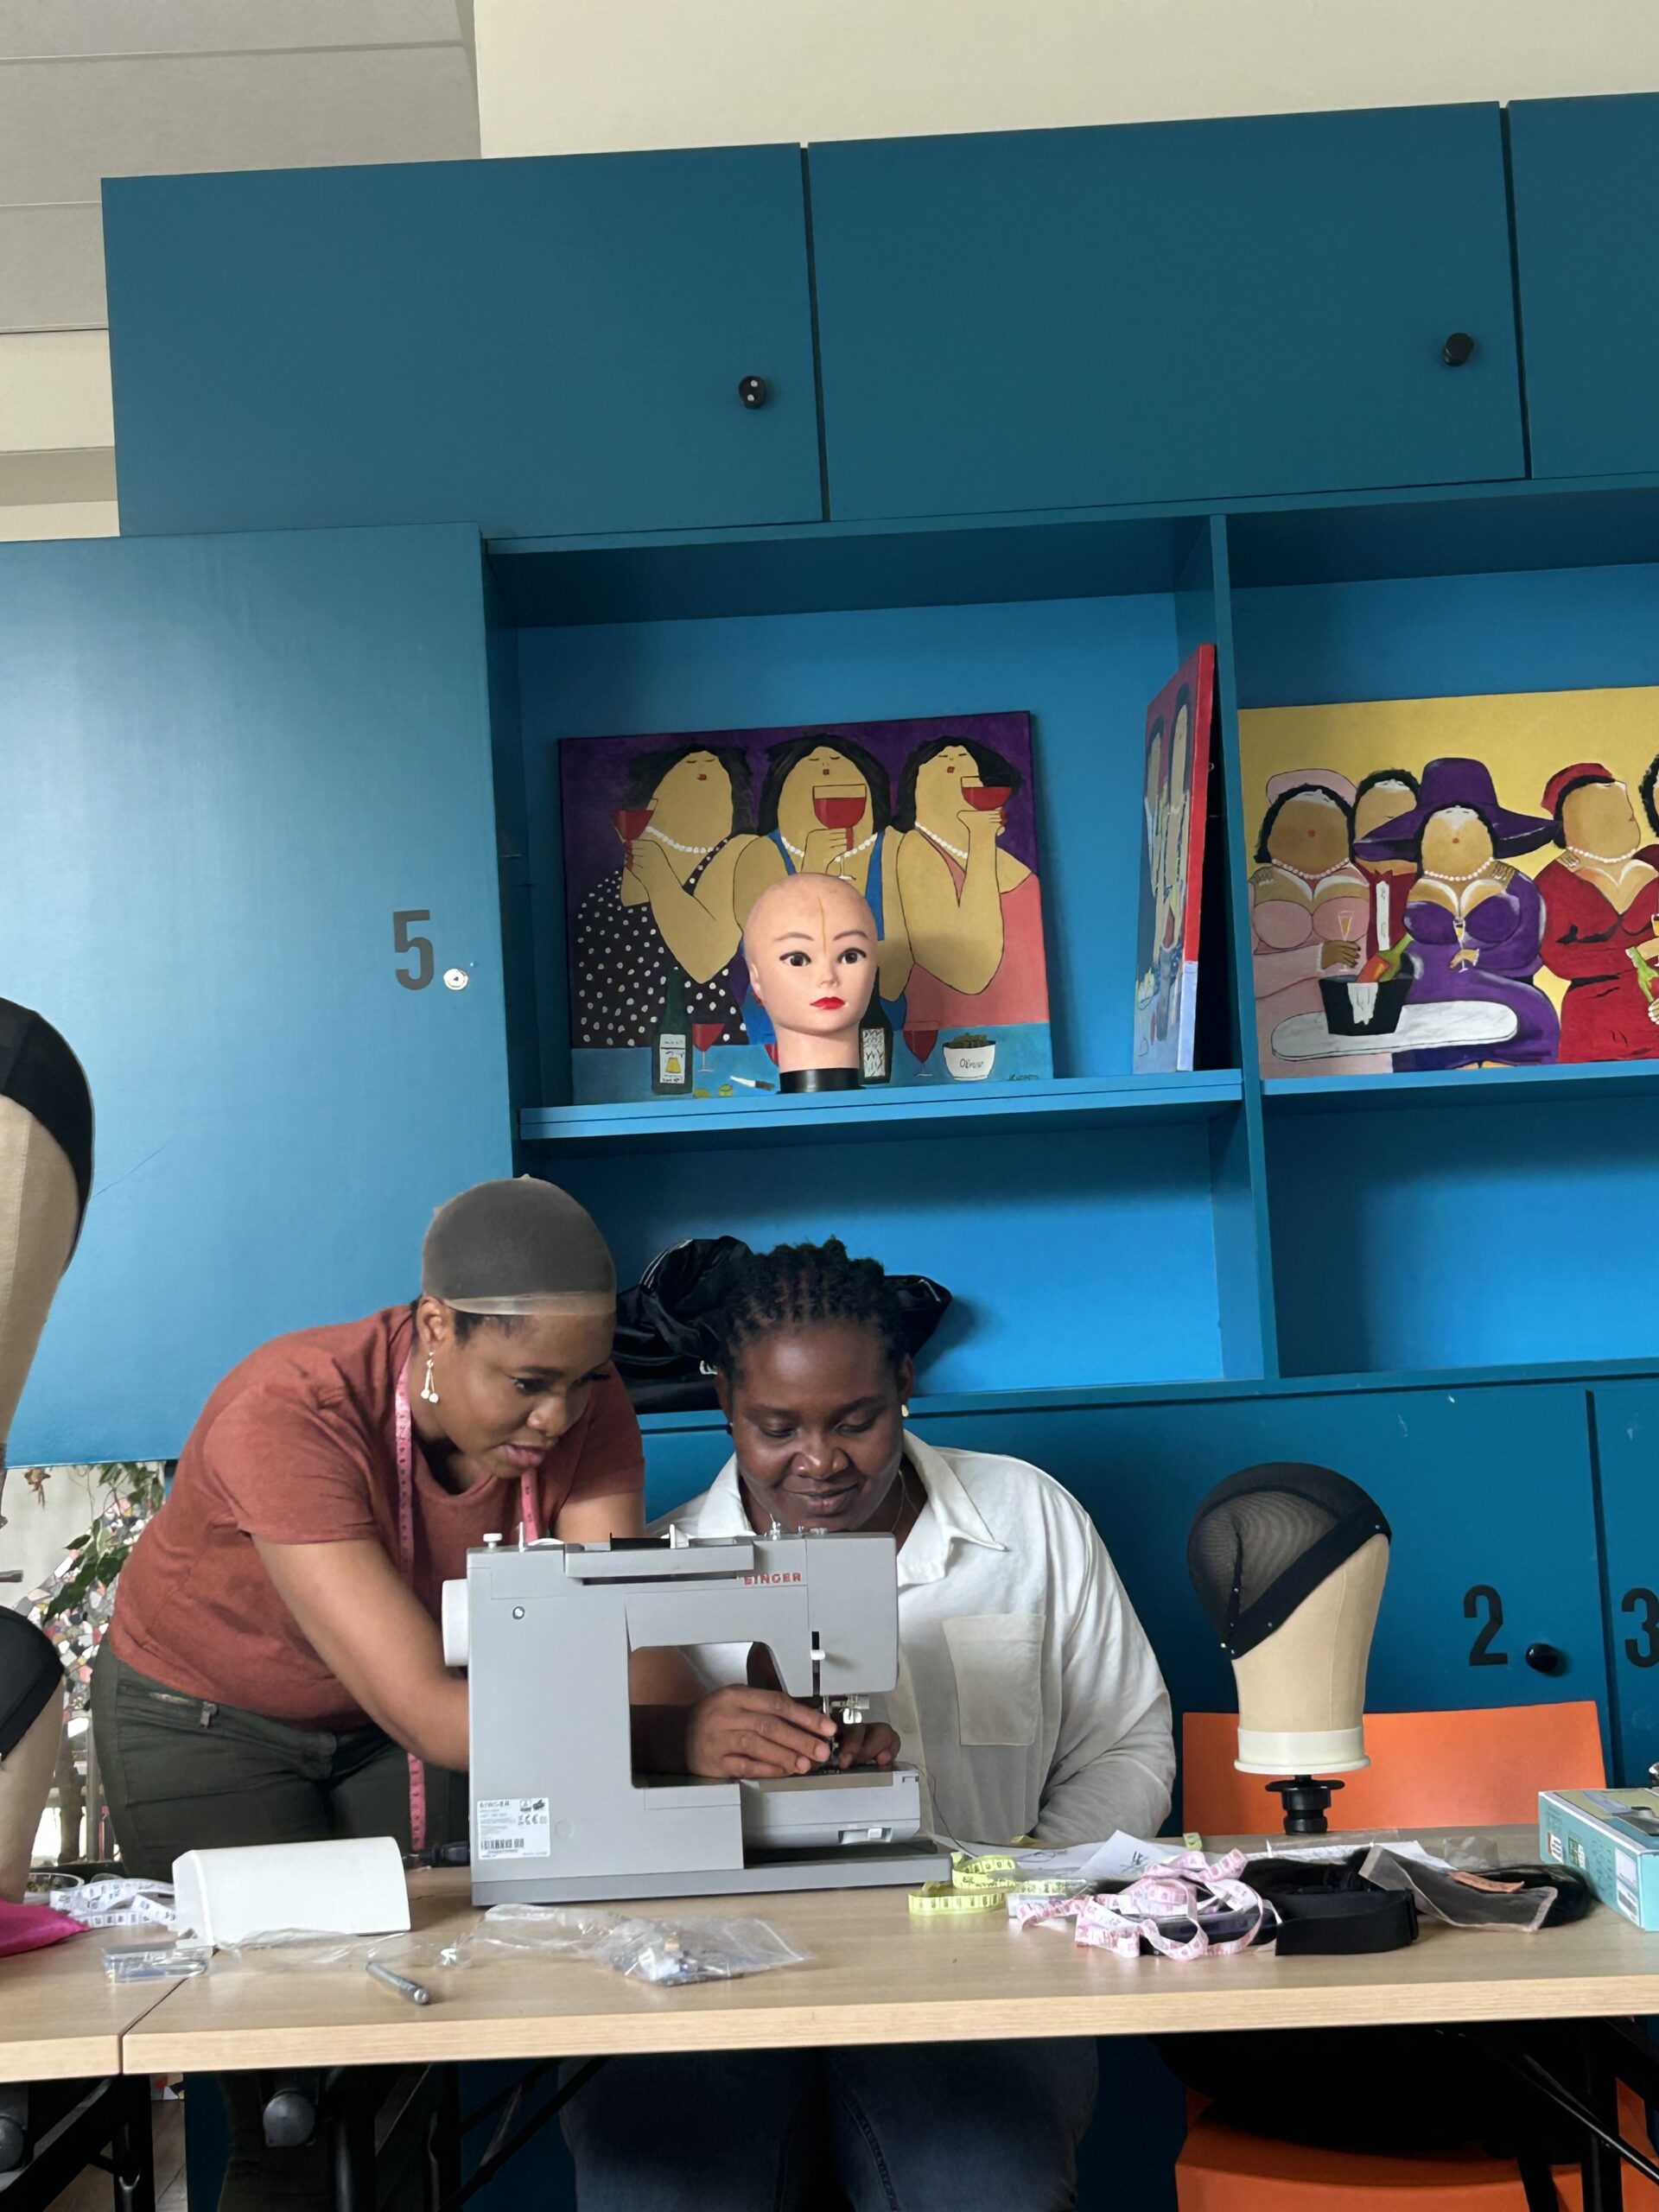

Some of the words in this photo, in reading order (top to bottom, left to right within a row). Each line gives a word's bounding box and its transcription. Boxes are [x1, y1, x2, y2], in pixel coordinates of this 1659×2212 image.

[393, 909, 434, 990] 5
[744, 1572, 802, 1586] SINGER
[1464, 1585, 1508, 1666] 2
[1621, 1587, 1659, 1668] 3
